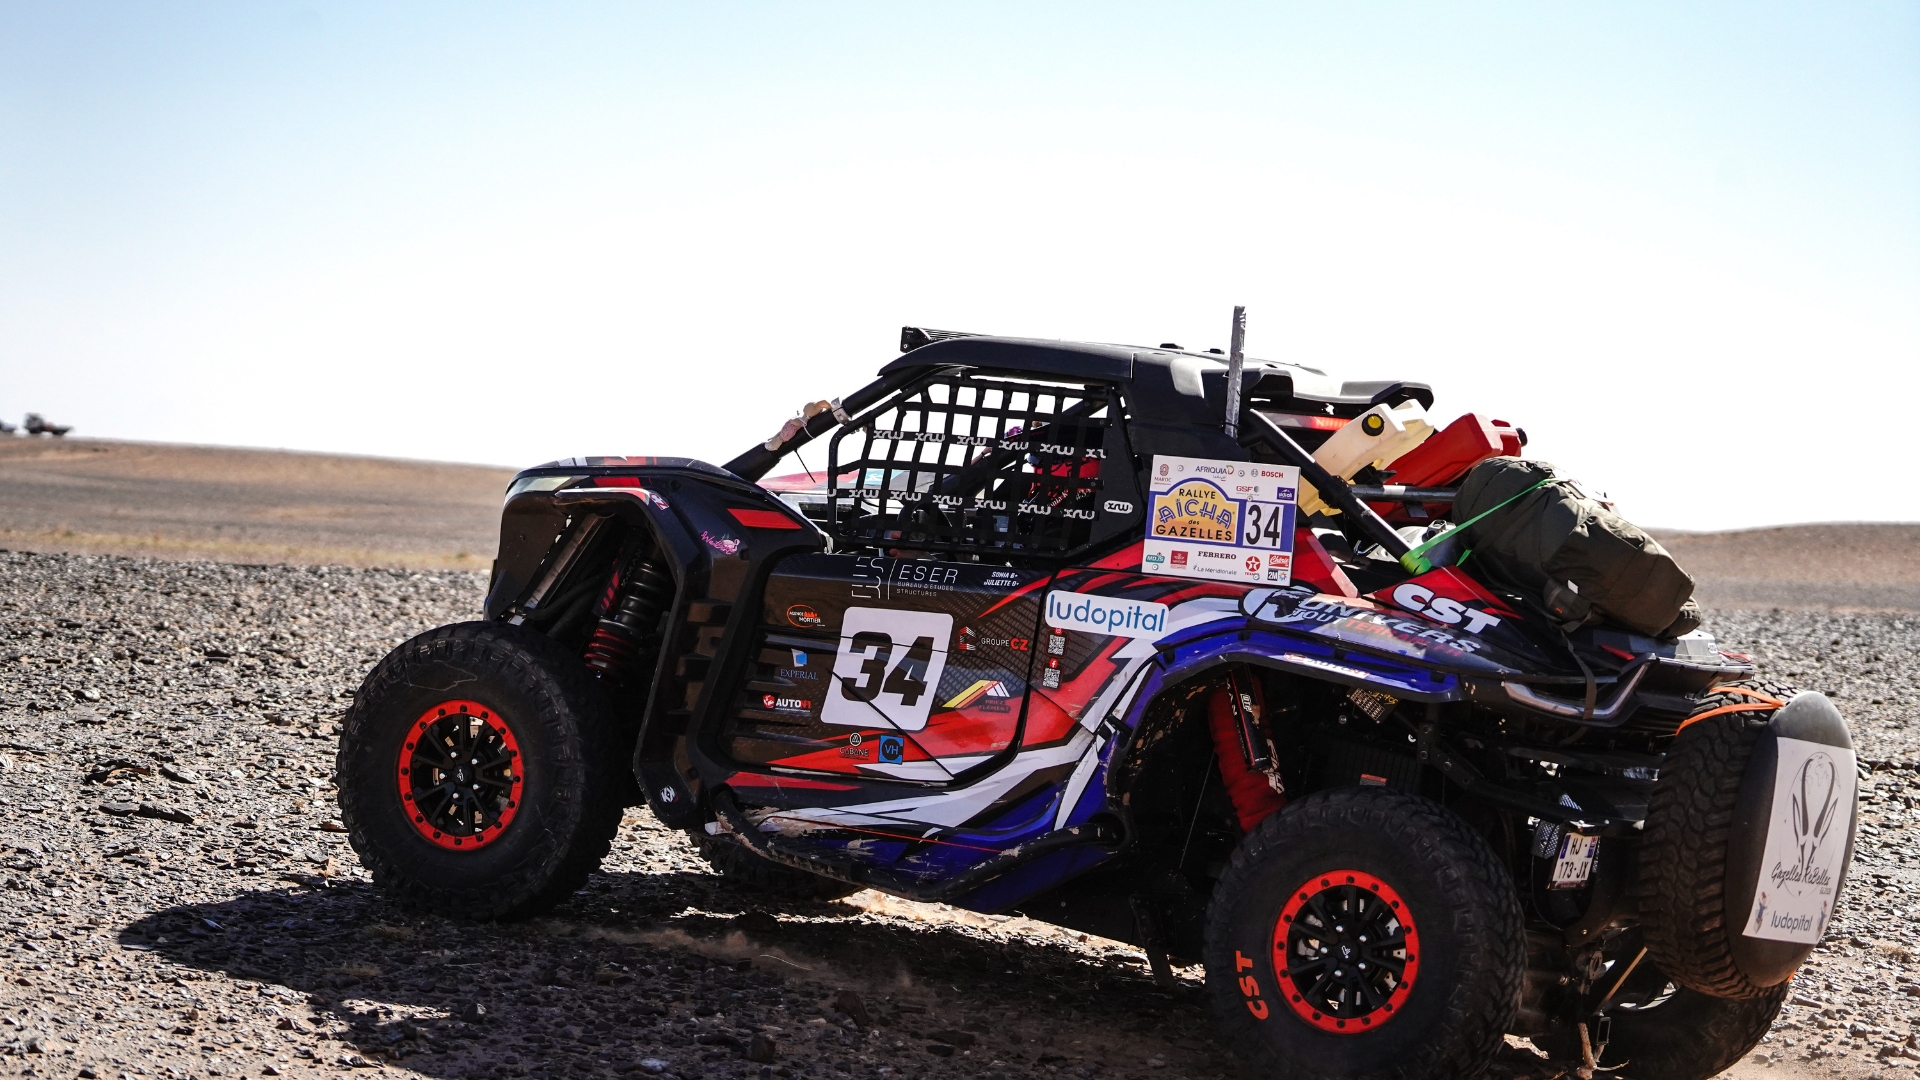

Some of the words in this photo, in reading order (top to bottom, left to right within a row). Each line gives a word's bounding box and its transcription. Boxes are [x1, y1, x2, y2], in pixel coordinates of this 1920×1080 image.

[1261, 470, 1284, 478] BOSCH
[1179, 488, 1216, 500] RALLYE
[1156, 524, 1232, 541] GAZELLES
[1245, 504, 1280, 547] 34
[1198, 550, 1237, 560] FERRERO
[898, 564, 959, 584] ESER
[1268, 571, 1278, 580] 2M
[897, 581, 921, 589] BUREAU
[983, 579, 1012, 587] JULIETTE
[896, 588, 937, 597] STRUCTURES
[1049, 594, 1166, 633] ludopital
[1293, 608, 1348, 625] TOUT
[1393, 583, 1501, 634] CST
[798, 616, 822, 624] MORTIER
[1298, 598, 1481, 653] UNIVERS
[981, 637, 1010, 647] GROUPE
[1010, 637, 1029, 651] CZ
[780, 668, 819, 680] EXPERIAL
[841, 631, 935, 707] 34
[884, 744, 899, 755] VH
[1558, 861, 1589, 879] 173-JX
[1771, 861, 1801, 889] Gazelles
[1771, 910, 1814, 934] ludopital
[1235, 950, 1269, 1021] CST
